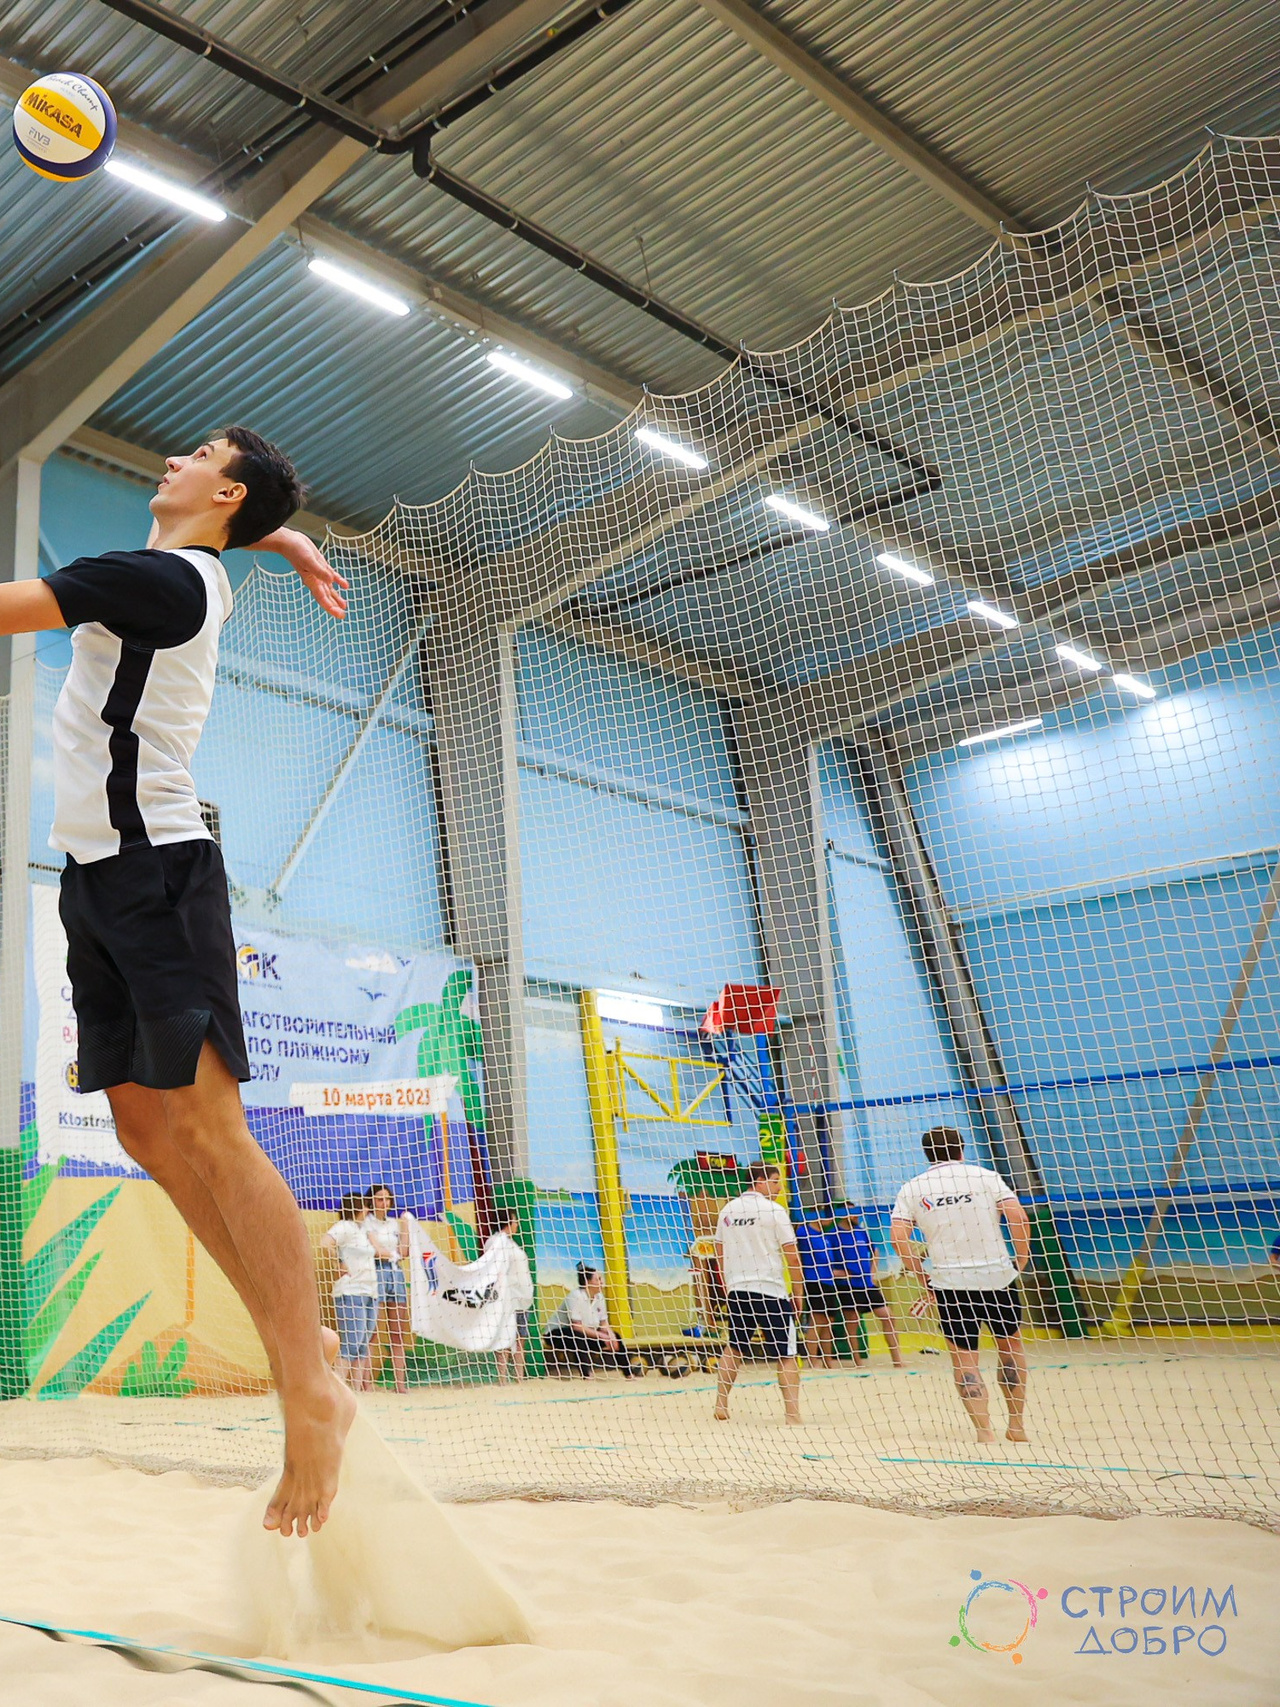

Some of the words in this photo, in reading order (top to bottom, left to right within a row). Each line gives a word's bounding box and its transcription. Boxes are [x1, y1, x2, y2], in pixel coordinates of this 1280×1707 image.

[24, 91, 83, 138] MIKASA
[28, 127, 51, 146] FIVB
[242, 1011, 397, 1045] АГОТВОРИТЕЛЬНЫЙ
[248, 1036, 272, 1055] ПО
[277, 1040, 370, 1066] ПЛЯЖНОМУ
[250, 1062, 281, 1083] ОЛУ
[322, 1087, 341, 1106] 10
[345, 1092, 393, 1110] марта
[395, 1087, 431, 1106] 2023
[935, 1194, 972, 1207] ZEVS
